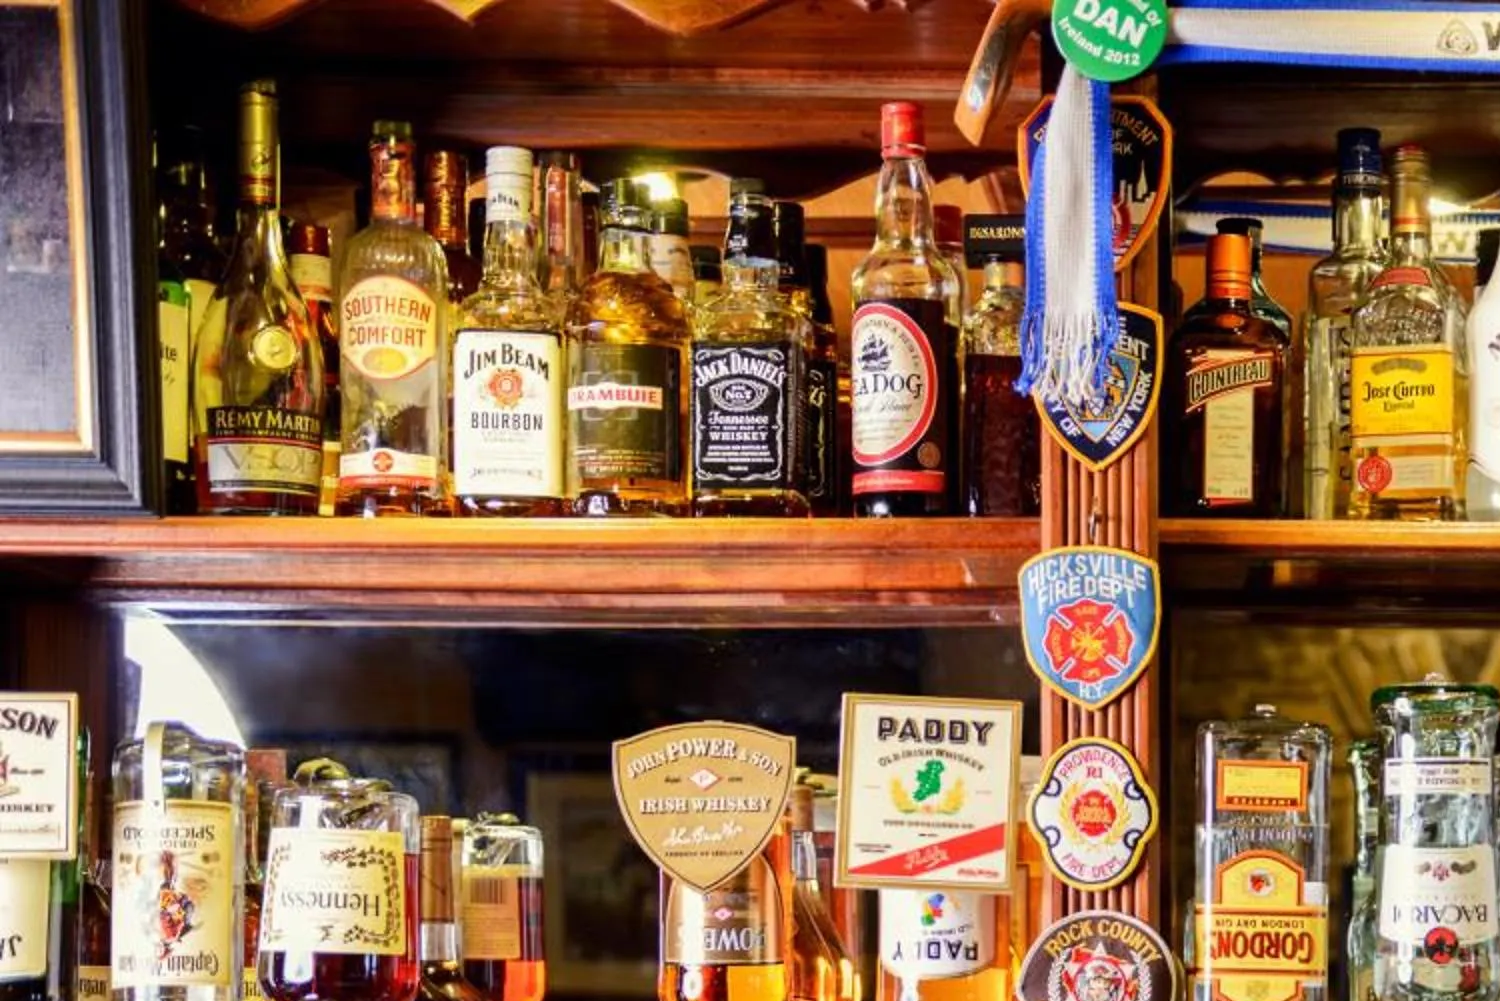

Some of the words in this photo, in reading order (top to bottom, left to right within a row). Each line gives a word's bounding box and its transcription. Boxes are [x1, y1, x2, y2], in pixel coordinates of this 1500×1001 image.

[1073, 0, 1148, 48] DAN
[1058, 16, 1103, 57] Ireland
[1104, 50, 1140, 66] 2012
[345, 295, 431, 323] SOUTHERN
[349, 325, 427, 349] COMFORT
[464, 347, 497, 380] JIM
[501, 343, 550, 381] BEAM
[695, 358, 731, 387] JACK
[730, 351, 787, 387] DANIEL'S
[873, 373, 923, 399] DOG
[1129, 371, 1153, 420] YORK
[1190, 359, 1267, 403] COINTREAU
[471, 411, 543, 431] BOURBON
[709, 431, 768, 441] WHISKEY
[1059, 417, 1081, 439] OF
[1106, 414, 1135, 448] NEW
[1028, 553, 1147, 599] HICKSVILLE
[1036, 577, 1081, 616] FIRE
[877, 716, 994, 747] PADDY
[627, 752, 665, 779] JOHN
[665, 737, 737, 761] POWER
[750, 749, 783, 778] SON
[1058, 749, 1132, 781] PROVIDENCE
[639, 798, 688, 816] IRISH
[689, 797, 773, 813] WHISKEY
[1236, 919, 1258, 929] DRY
[1261, 919, 1305, 929] LONDON
[1044, 919, 1094, 958] ROCK
[1097, 919, 1162, 963] COUNTY
